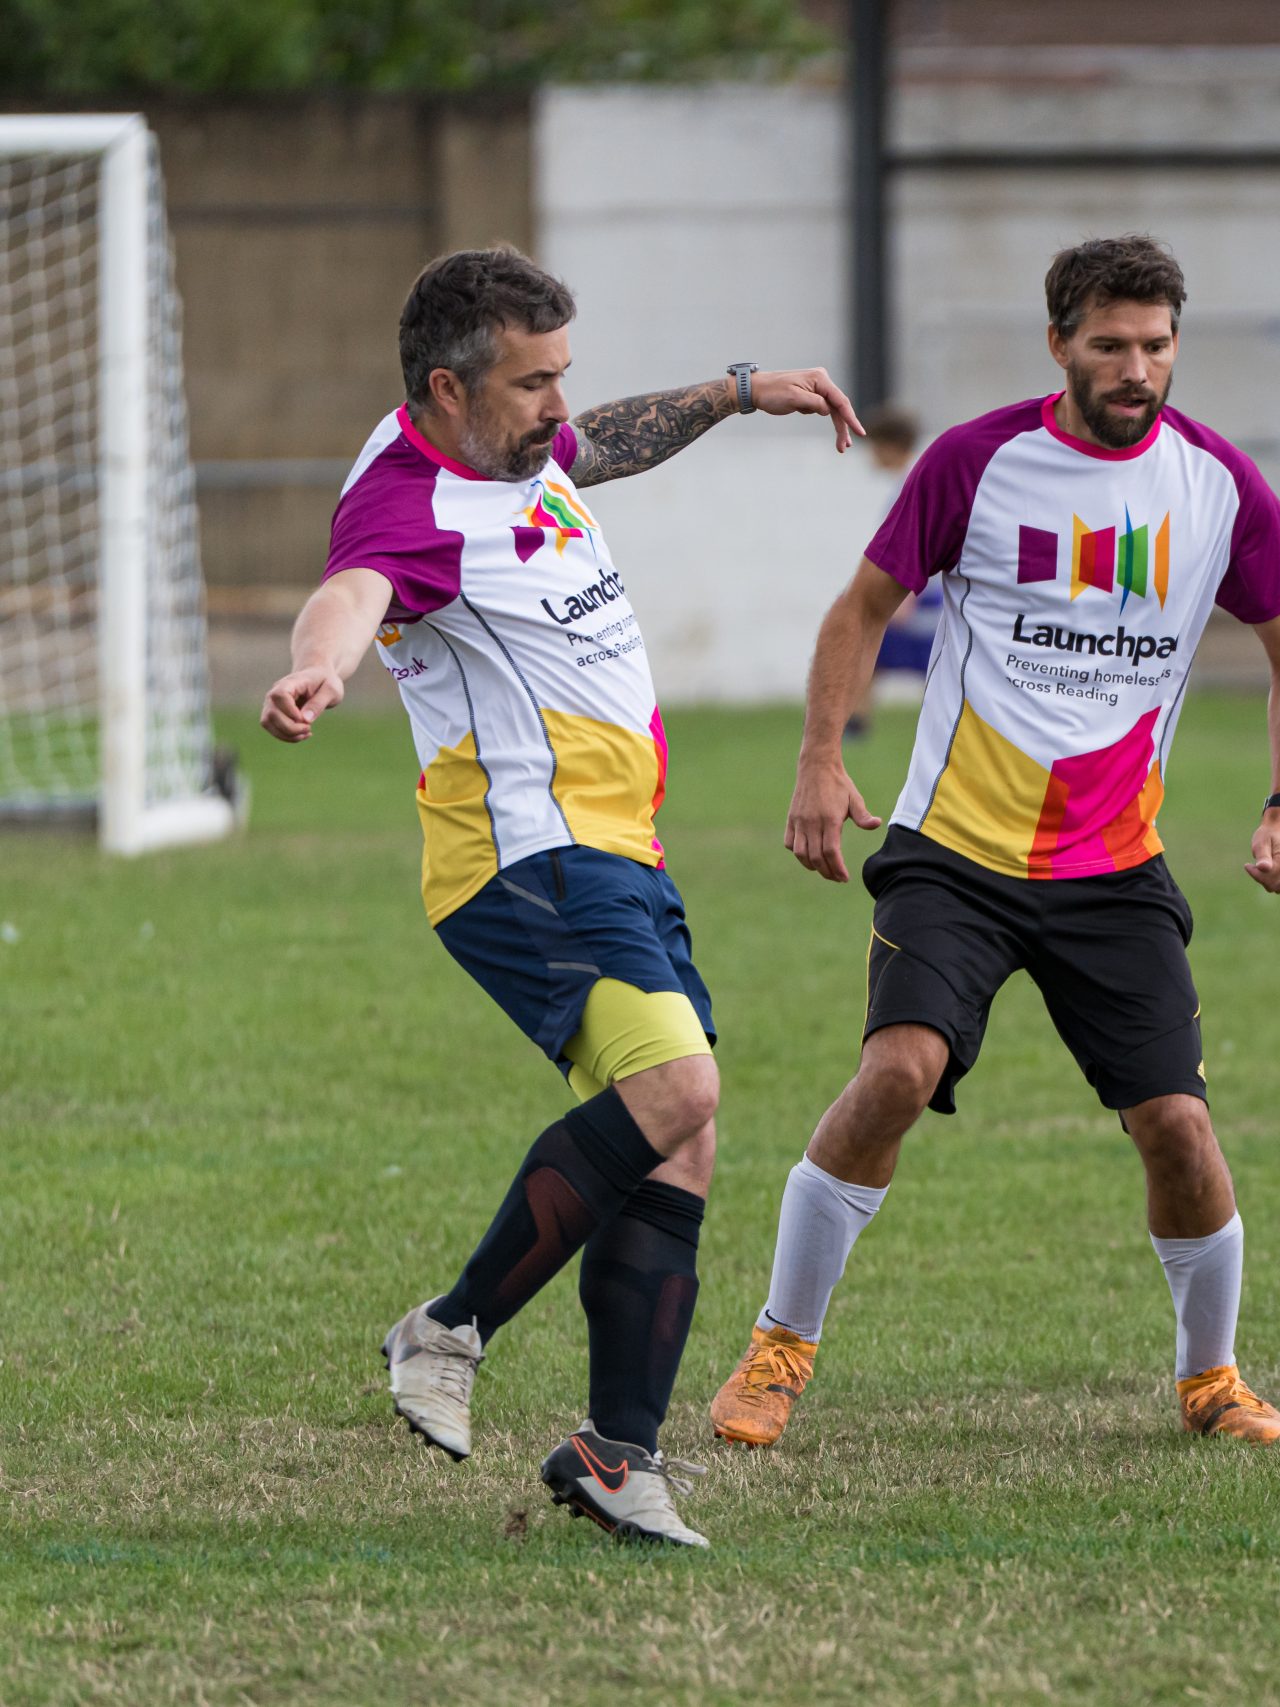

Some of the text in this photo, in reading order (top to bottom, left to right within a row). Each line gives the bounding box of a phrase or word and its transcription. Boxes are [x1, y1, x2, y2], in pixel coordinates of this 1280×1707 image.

[566, 621, 624, 646] Preenting
[1012, 613, 1179, 666] Launchpa
[576, 649, 620, 668] across
[1006, 653, 1090, 684] Preventing
[1055, 682, 1119, 706] Reading
